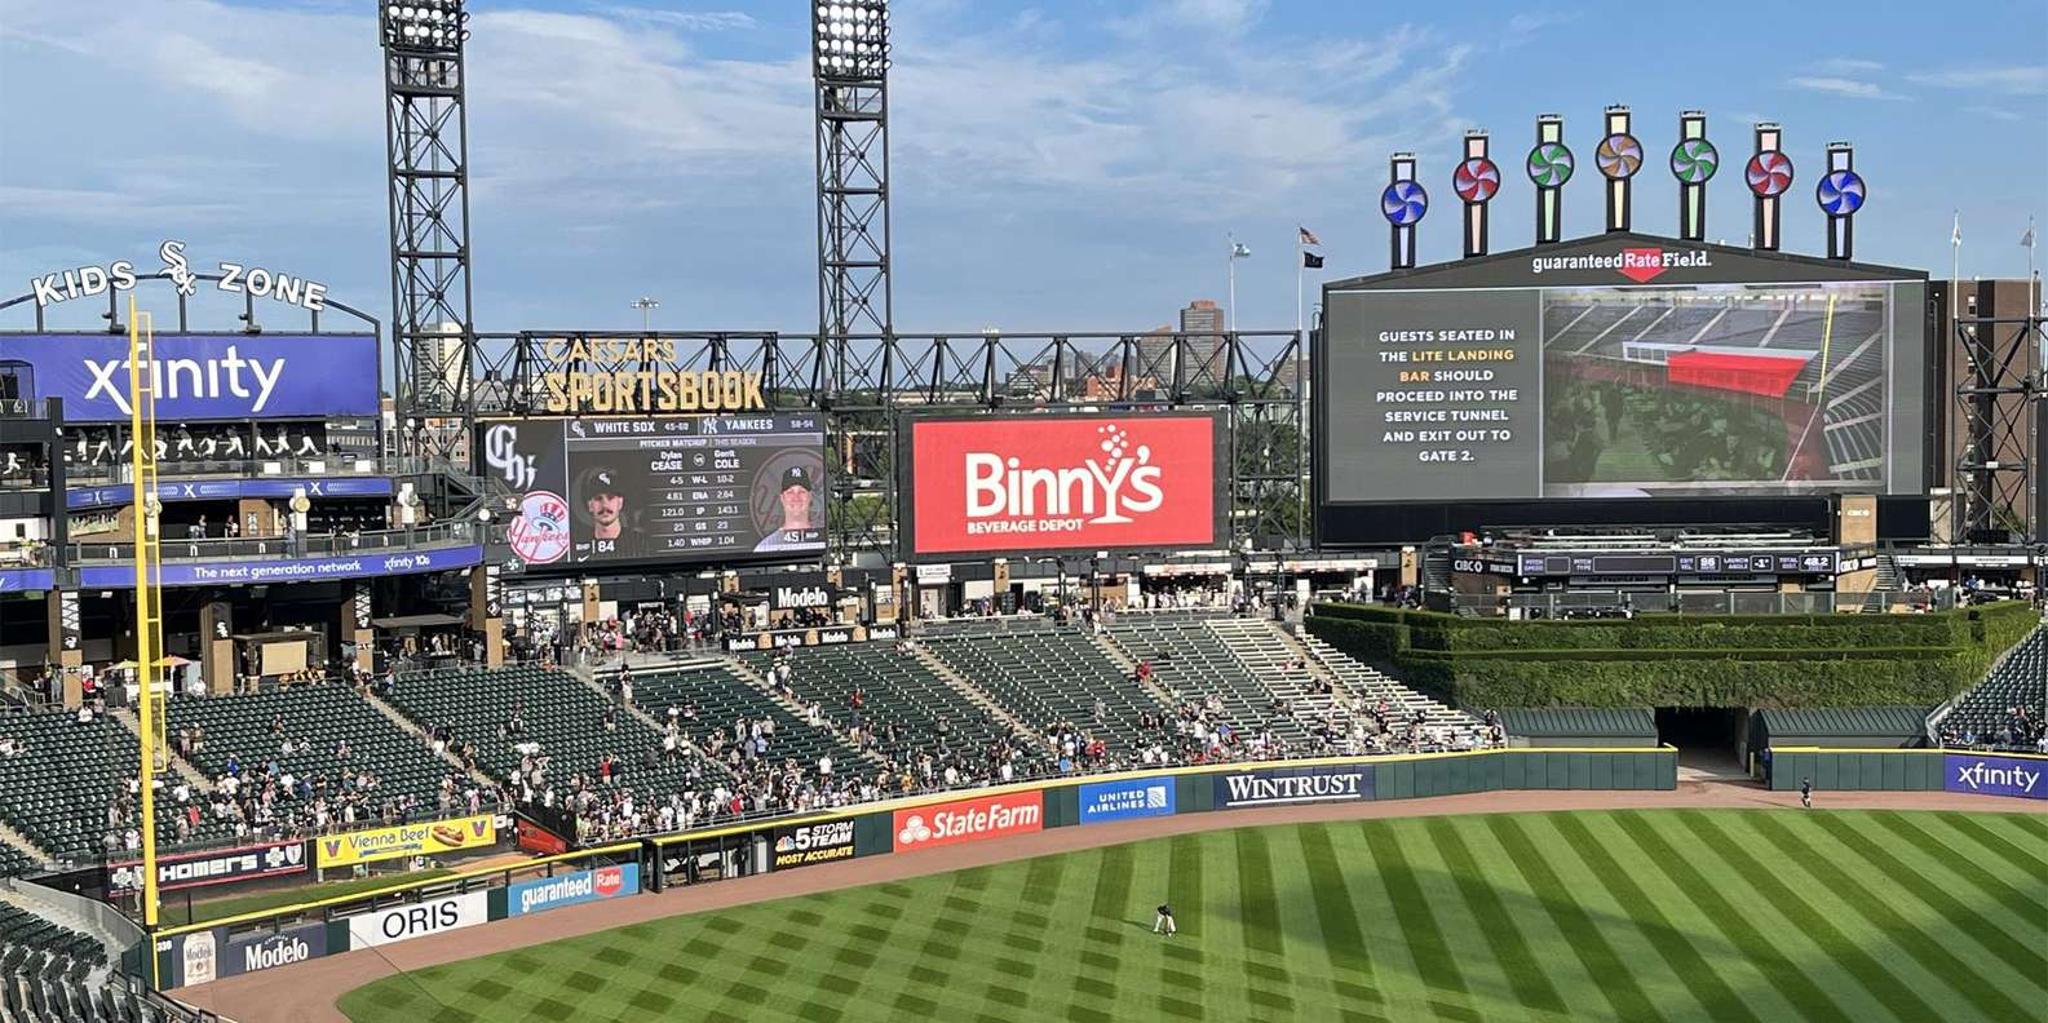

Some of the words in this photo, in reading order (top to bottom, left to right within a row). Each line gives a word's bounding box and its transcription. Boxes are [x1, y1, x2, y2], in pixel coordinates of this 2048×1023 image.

[1532, 252, 1623, 273] guaranteed
[1624, 252, 1660, 268] Rate
[31, 261, 136, 307] KIDS
[217, 262, 327, 311] ZONE
[1379, 331, 1435, 343] GUESTS
[1438, 330, 1495, 342] SEATED
[1499, 330, 1516, 340] IN
[545, 338, 677, 363] CAESARS
[1379, 351, 1408, 362] THE
[1412, 350, 1443, 362] LITE
[1448, 350, 1514, 361] LANDING
[84, 345, 285, 413] xfinity
[1400, 371, 1431, 382] BAR
[1434, 370, 1494, 382] SHOULD
[546, 370, 765, 412] SPORTSBOOK
[1376, 391, 1445, 402] PROCEED
[1449, 390, 1485, 401] INTO
[1489, 390, 1518, 400] THE
[1384, 411, 1446, 422] SERVICE
[1450, 410, 1509, 421] TUNNEL
[594, 421, 629, 433] WHITE
[632, 421, 655, 432] SOX
[725, 419, 773, 430] YANKEES
[1383, 432, 1415, 442] AND
[1419, 431, 1450, 442] EXIT
[1455, 430, 1486, 441] OUT
[1490, 430, 1511, 441] TO
[661, 451, 682, 460] Dylan
[1419, 451, 1457, 461] GATE
[1460, 451, 1475, 461] 2.
[651, 461, 682, 471] CEASE
[714, 459, 740, 468] COLE
[967, 521, 1036, 534] BEVERAGE
[1039, 518, 1083, 531] DEPOT
[784, 531, 799, 541] 45
[598, 541, 614, 552] 84
[1701, 558, 1715, 566] 96
[194, 567, 217, 578] The
[220, 566, 248, 577] next
[251, 563, 314, 579] generation
[318, 561, 361, 573] network
[778, 586, 828, 608] Modelo
[822, 631, 848, 643] Modelo
[870, 628, 895, 640] Modelo
[729, 639, 755, 650] Modelo
[1958, 762, 2040, 792] xfinity
[1226, 774, 1362, 800] WINTRUST
[1099, 791, 1144, 802] UNITED
[1088, 801, 1145, 813] AIRLINES
[348, 831, 396, 849] Vienna
[400, 826, 430, 842] Beef
[795, 827, 810, 850] 5
[812, 821, 854, 837] STORM
[811, 832, 852, 847] TEAM
[776, 852, 804, 866] MOST
[804, 845, 854, 863] ACCURATE
[521, 874, 592, 912] guaranteed
[596, 870, 621, 886] Rate
[382, 901, 459, 939] ORIS
[245, 937, 309, 972] Modelo
